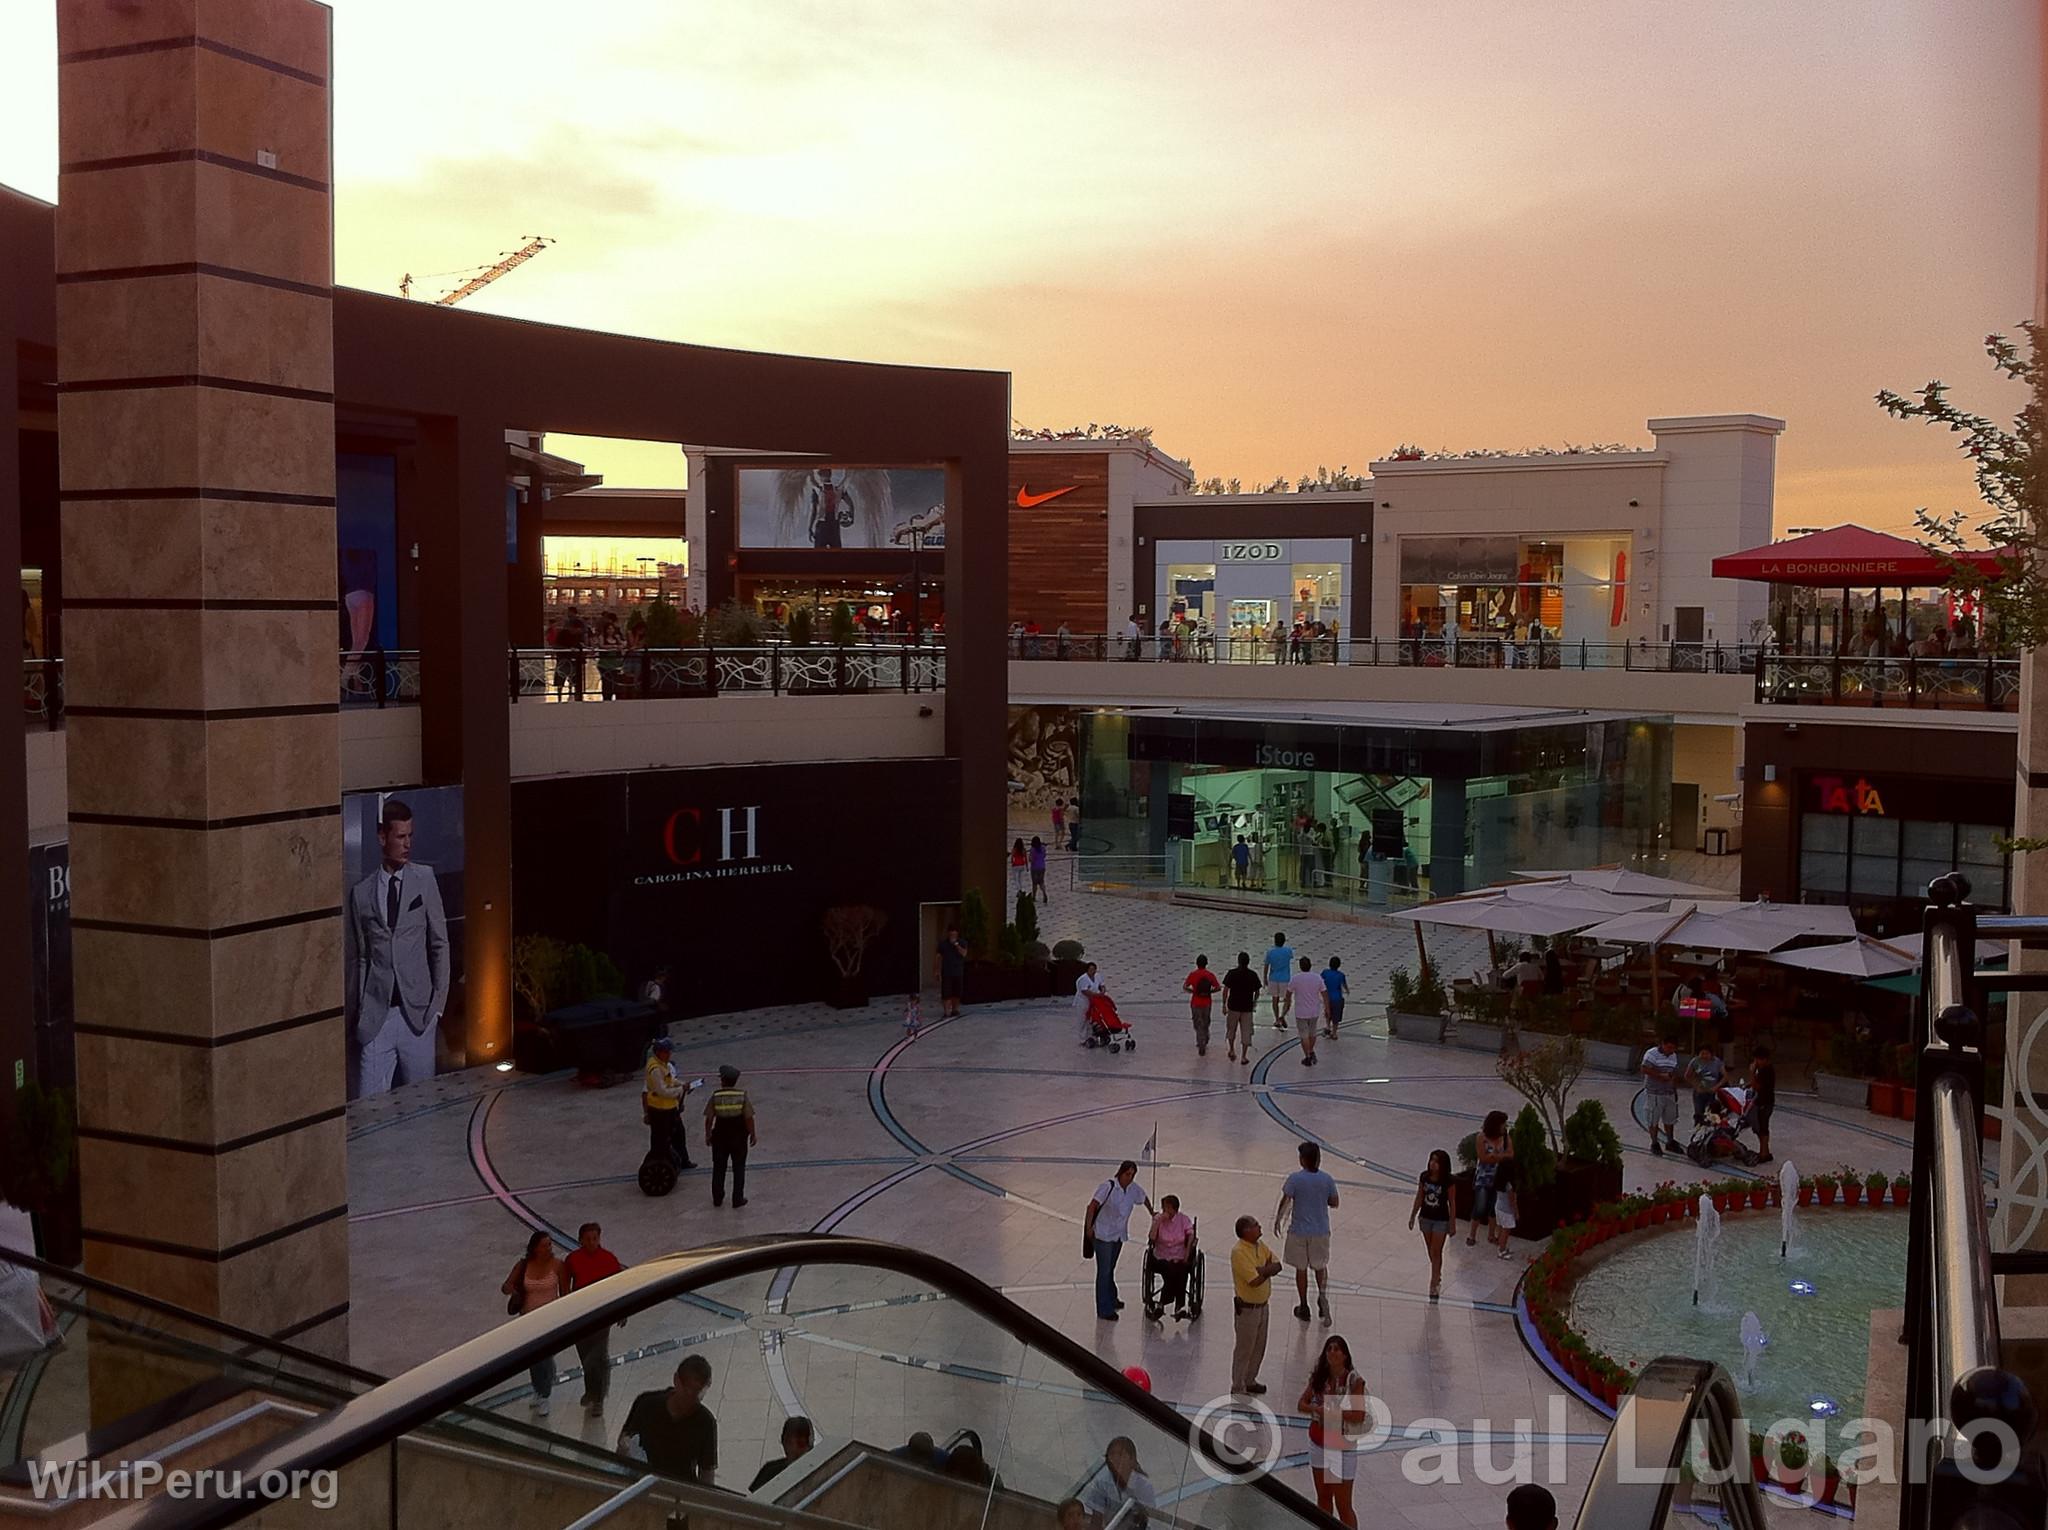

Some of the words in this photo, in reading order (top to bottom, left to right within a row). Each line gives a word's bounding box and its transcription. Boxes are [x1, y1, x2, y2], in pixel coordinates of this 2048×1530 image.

[1221, 543, 1280, 560] IZOD
[1761, 563, 1781, 574] LA
[1786, 562, 1898, 574] BONBONNIERE
[1255, 743, 1316, 767] iStore
[634, 871, 712, 885] CAROLINA
[717, 864, 794, 877] HERRERA
